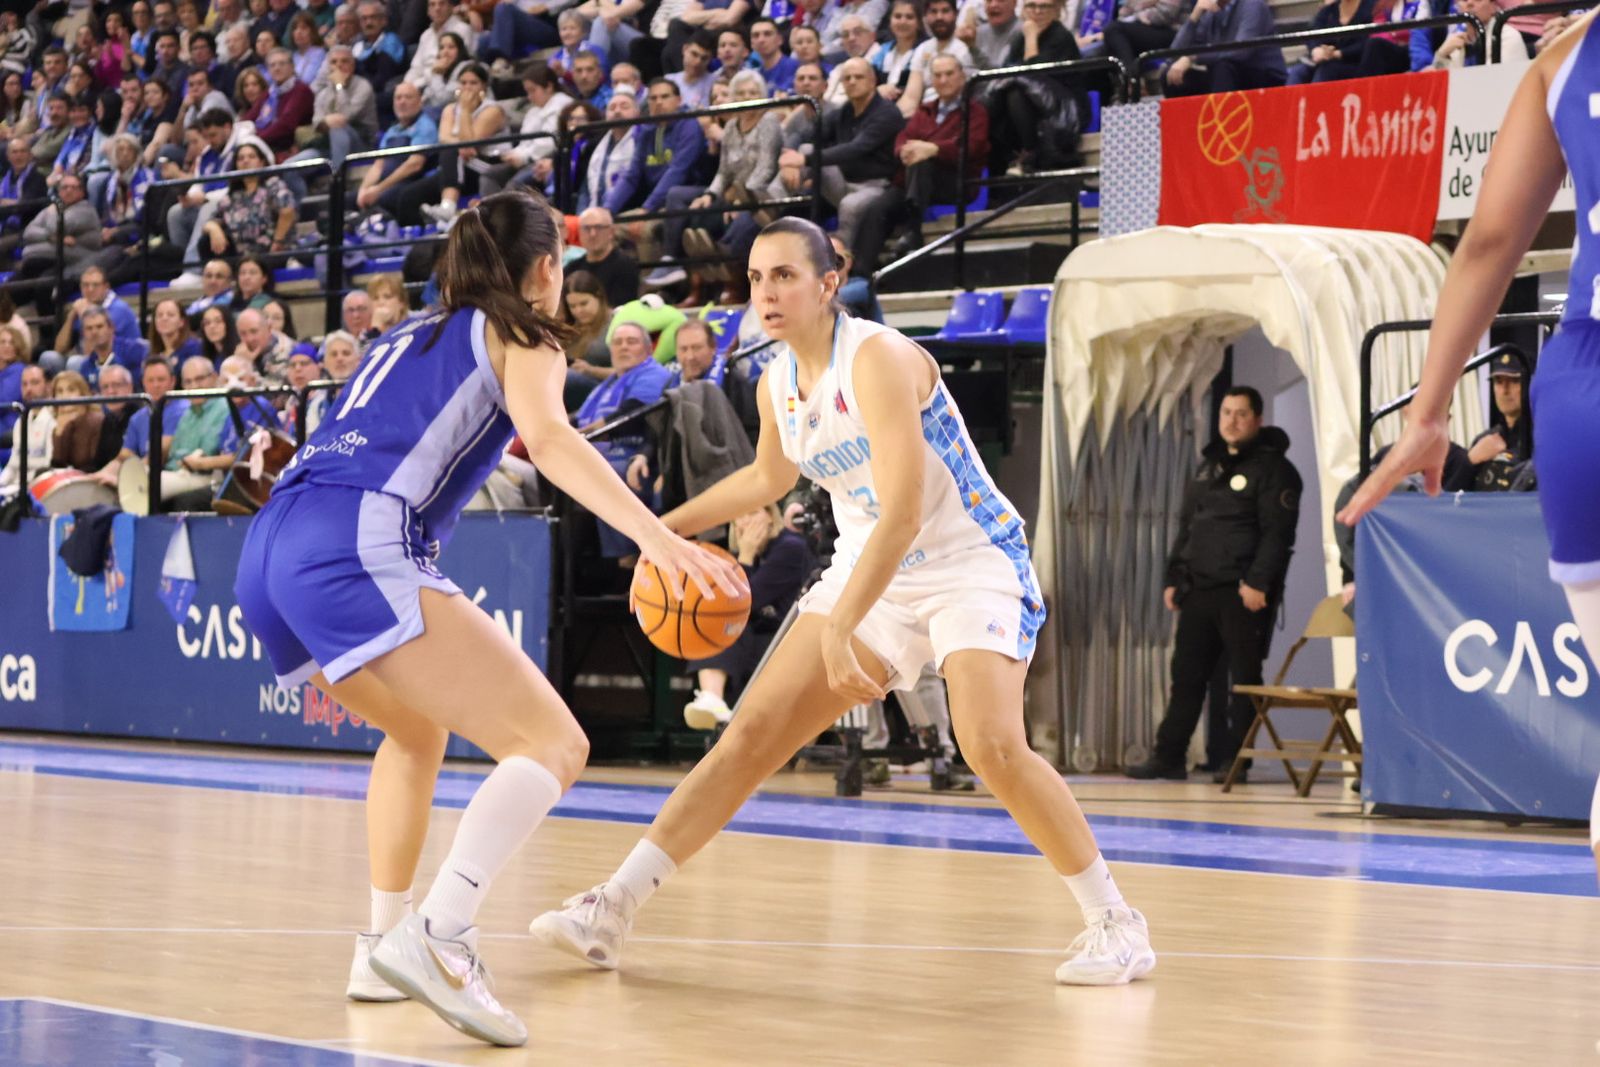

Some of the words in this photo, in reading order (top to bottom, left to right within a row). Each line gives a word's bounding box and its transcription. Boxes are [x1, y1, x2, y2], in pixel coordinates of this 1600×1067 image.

[1296, 97, 1331, 161] La
[1341, 93, 1437, 159] Ranita
[1448, 167, 1473, 198] de
[335, 334, 414, 421] 11
[259, 683, 301, 715] NOS
